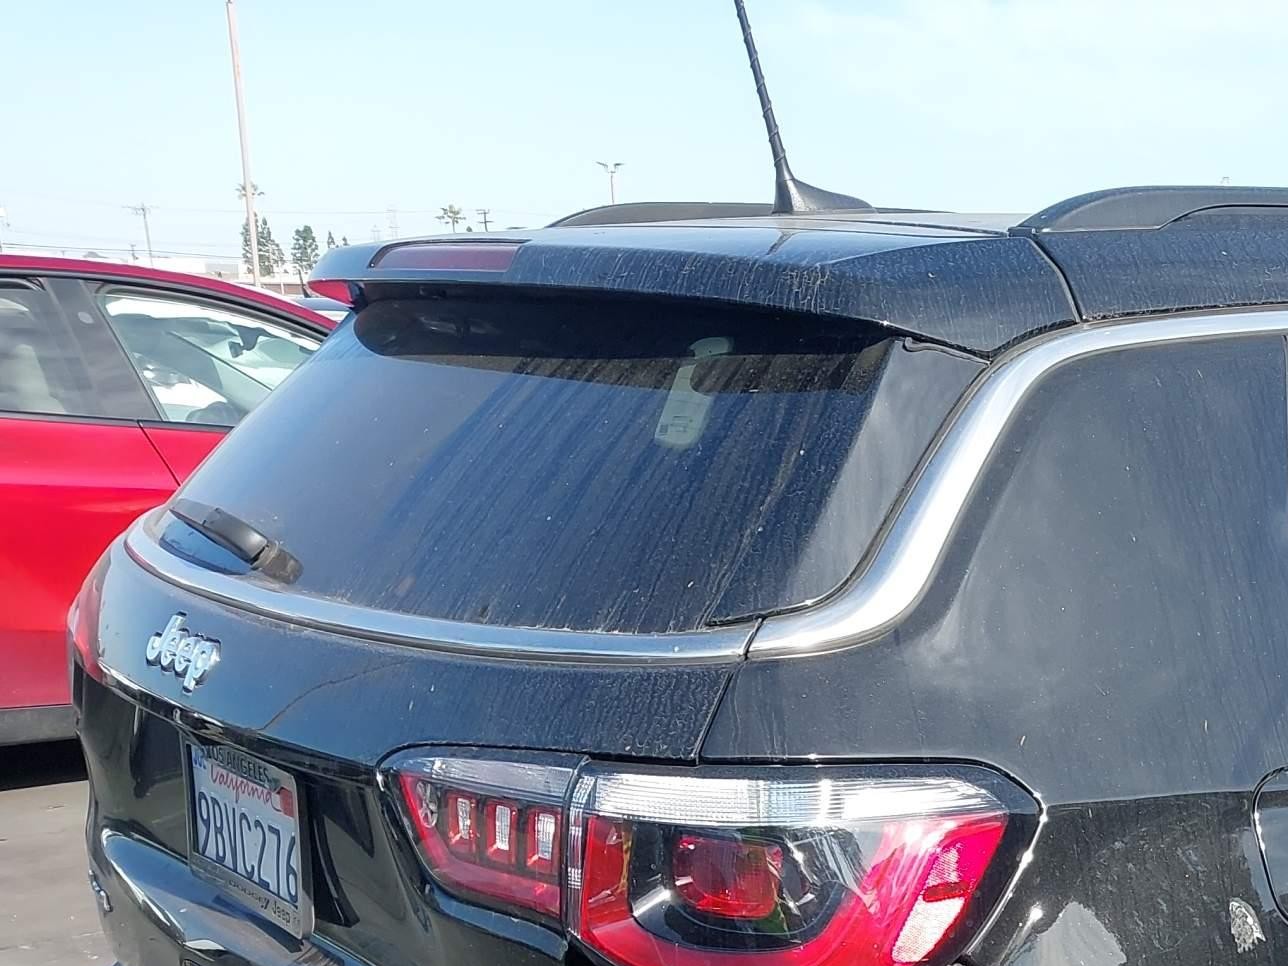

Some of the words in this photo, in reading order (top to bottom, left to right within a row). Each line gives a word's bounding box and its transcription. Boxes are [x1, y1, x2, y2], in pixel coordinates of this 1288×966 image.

[146, 611, 221, 695] Jeep
[226, 751, 272, 784] ANGELES
[198, 791, 298, 903] 9BVC276
